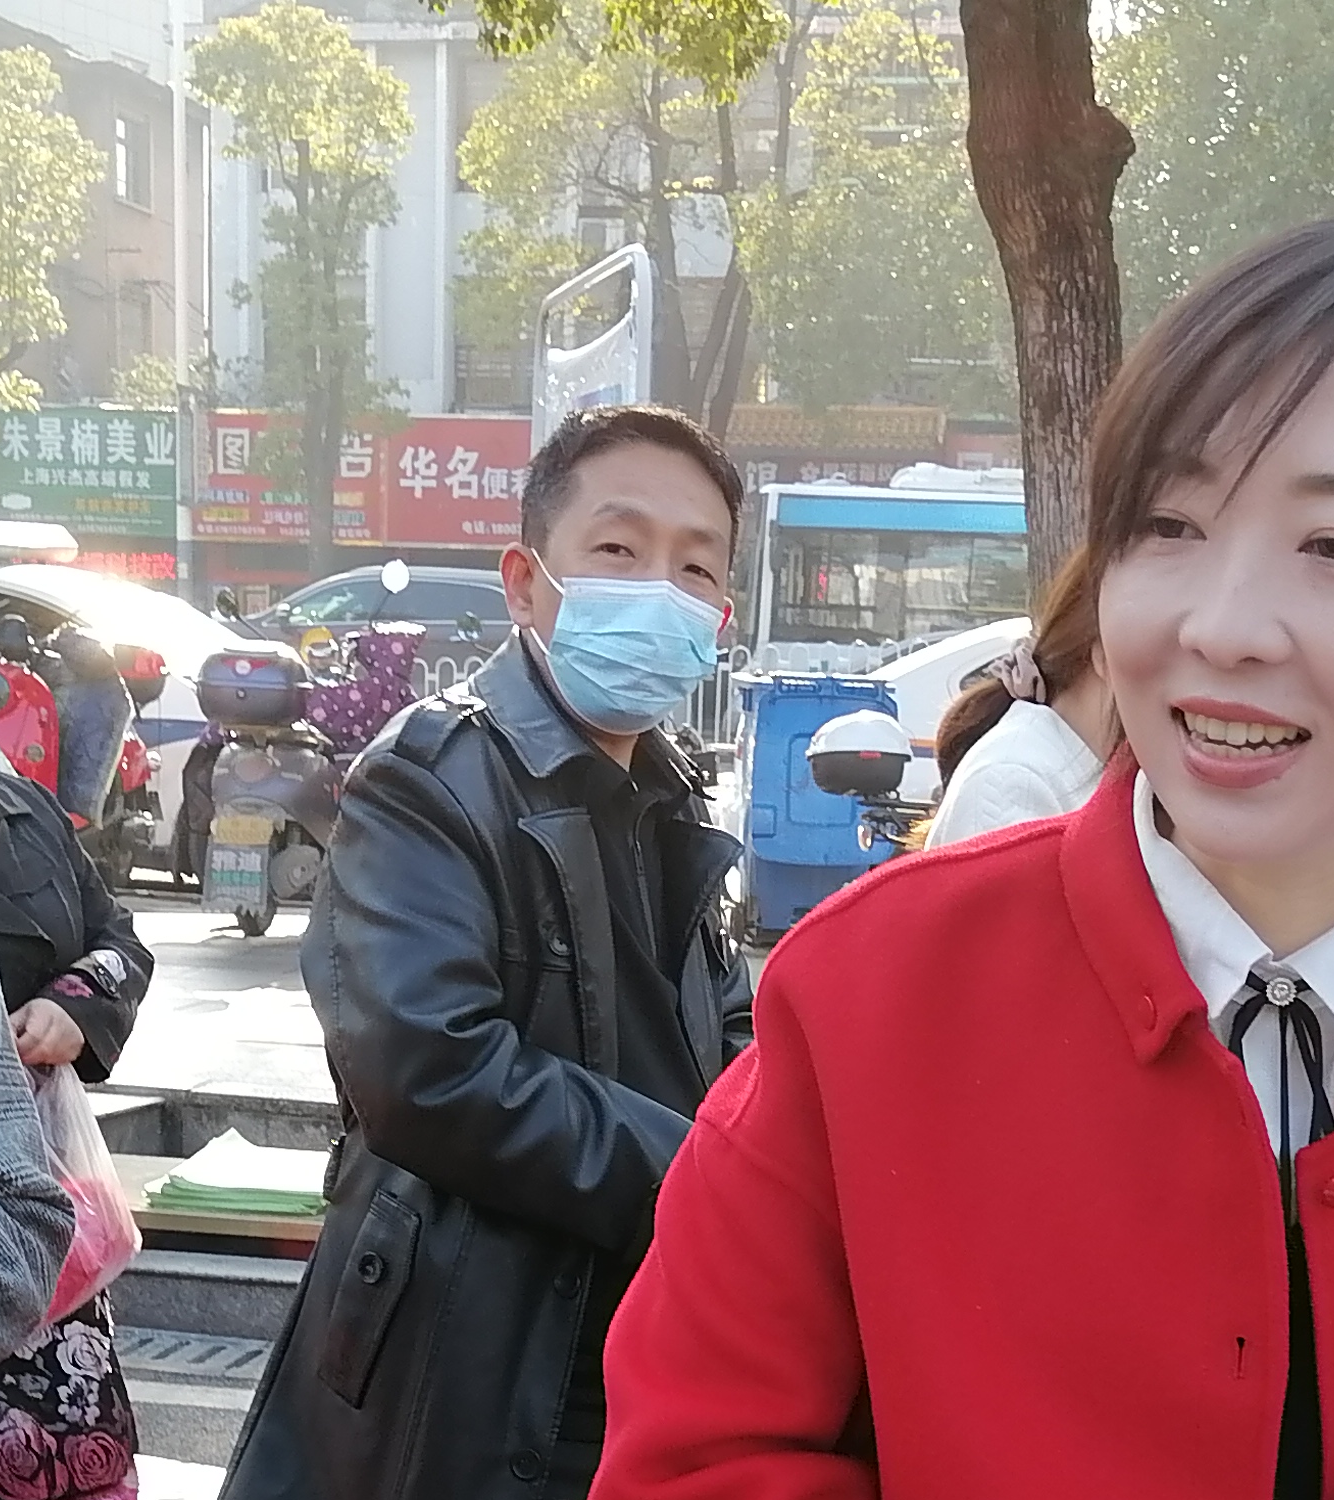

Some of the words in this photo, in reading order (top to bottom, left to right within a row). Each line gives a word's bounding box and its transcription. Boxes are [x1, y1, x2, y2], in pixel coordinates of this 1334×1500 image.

[2, 416, 174, 466] 朱景楠美业
